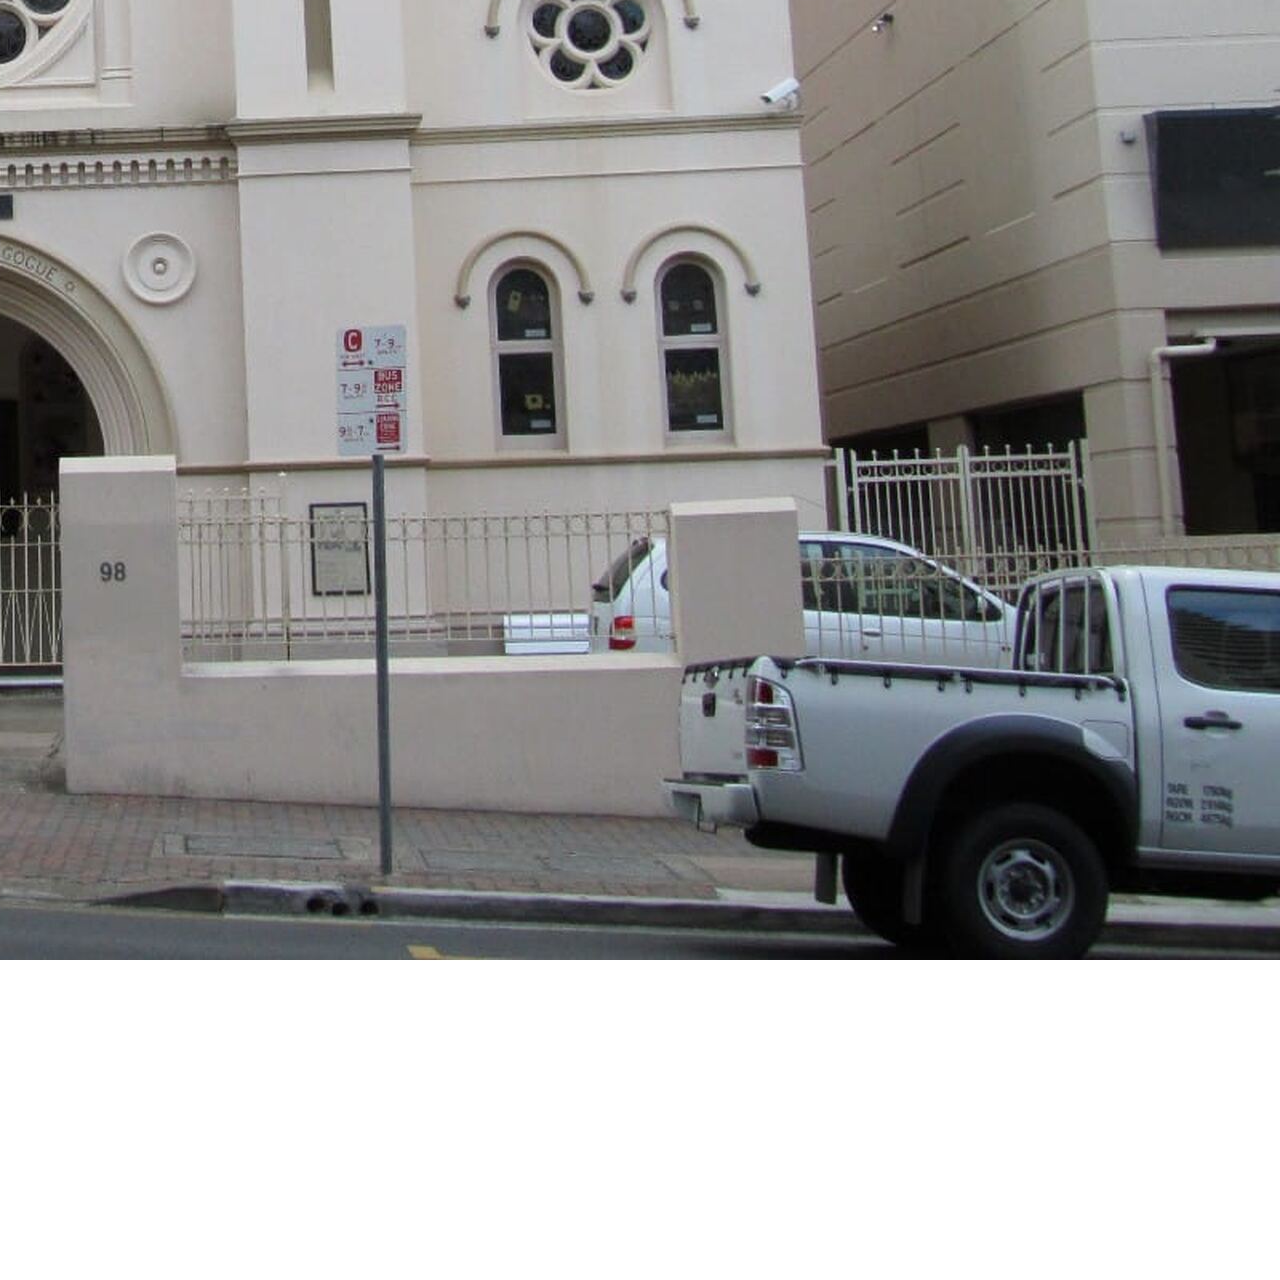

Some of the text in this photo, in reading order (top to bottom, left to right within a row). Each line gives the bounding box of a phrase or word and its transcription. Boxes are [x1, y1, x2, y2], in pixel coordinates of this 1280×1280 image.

[348, 331, 358, 350] C
[378, 370, 398, 381] BUS
[374, 382, 402, 393] ZONE
[100, 561, 126, 582] 98
